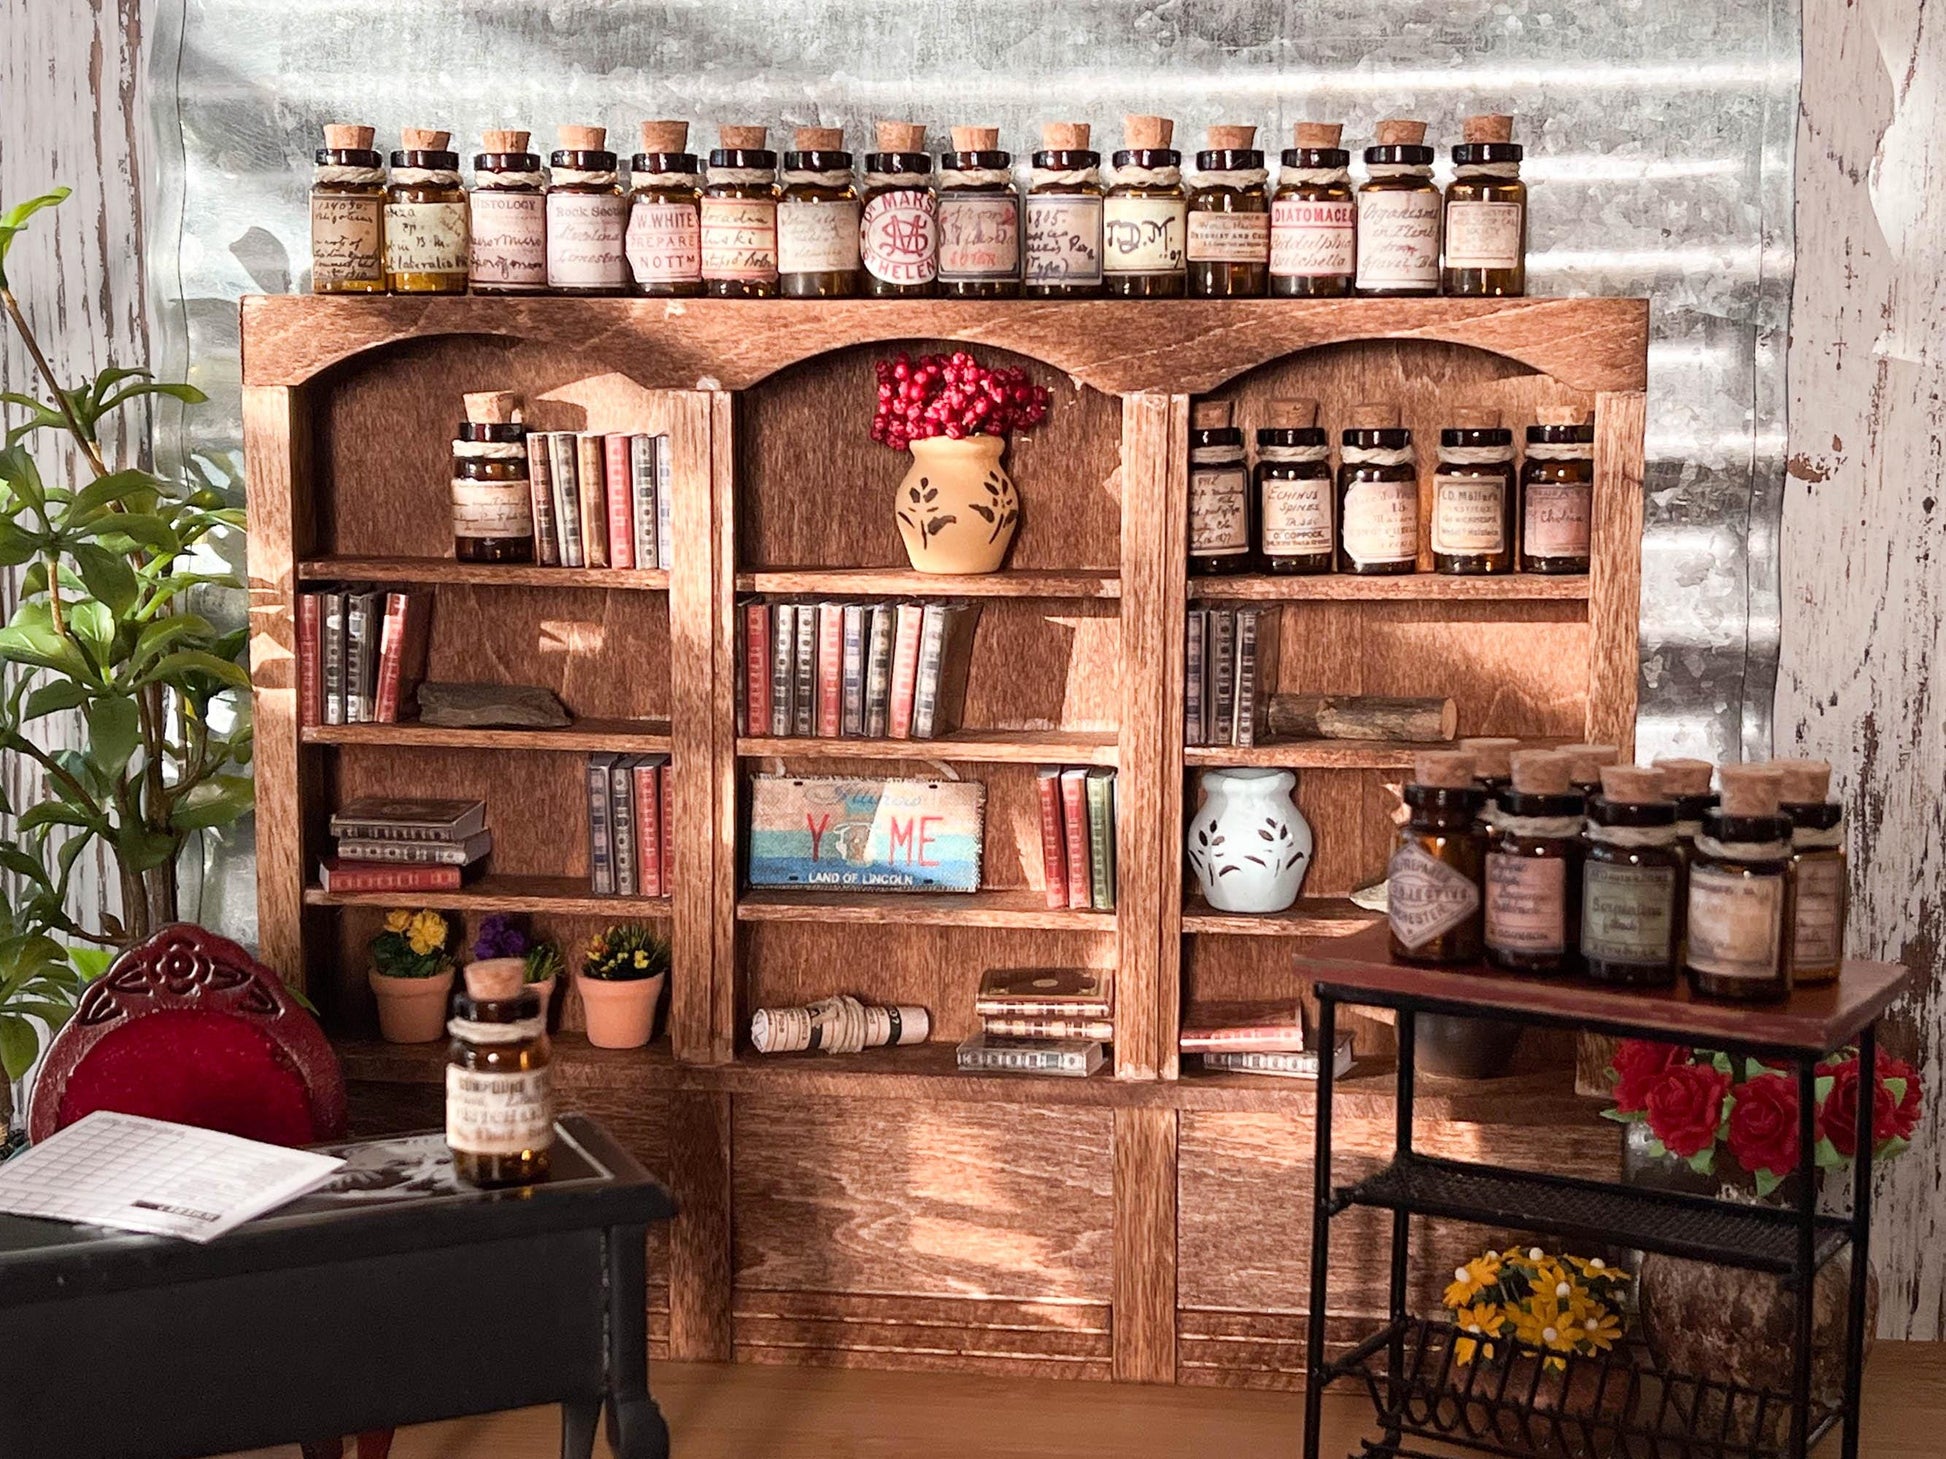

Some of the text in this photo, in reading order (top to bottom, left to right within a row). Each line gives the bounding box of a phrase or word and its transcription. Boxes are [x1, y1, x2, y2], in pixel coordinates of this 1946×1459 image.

[473, 197, 536, 210] HISTOLOGY
[652, 212, 696, 228] WHITE
[887, 816, 944, 867] ME
[808, 871, 913, 886] LAND OF LINCOLN
